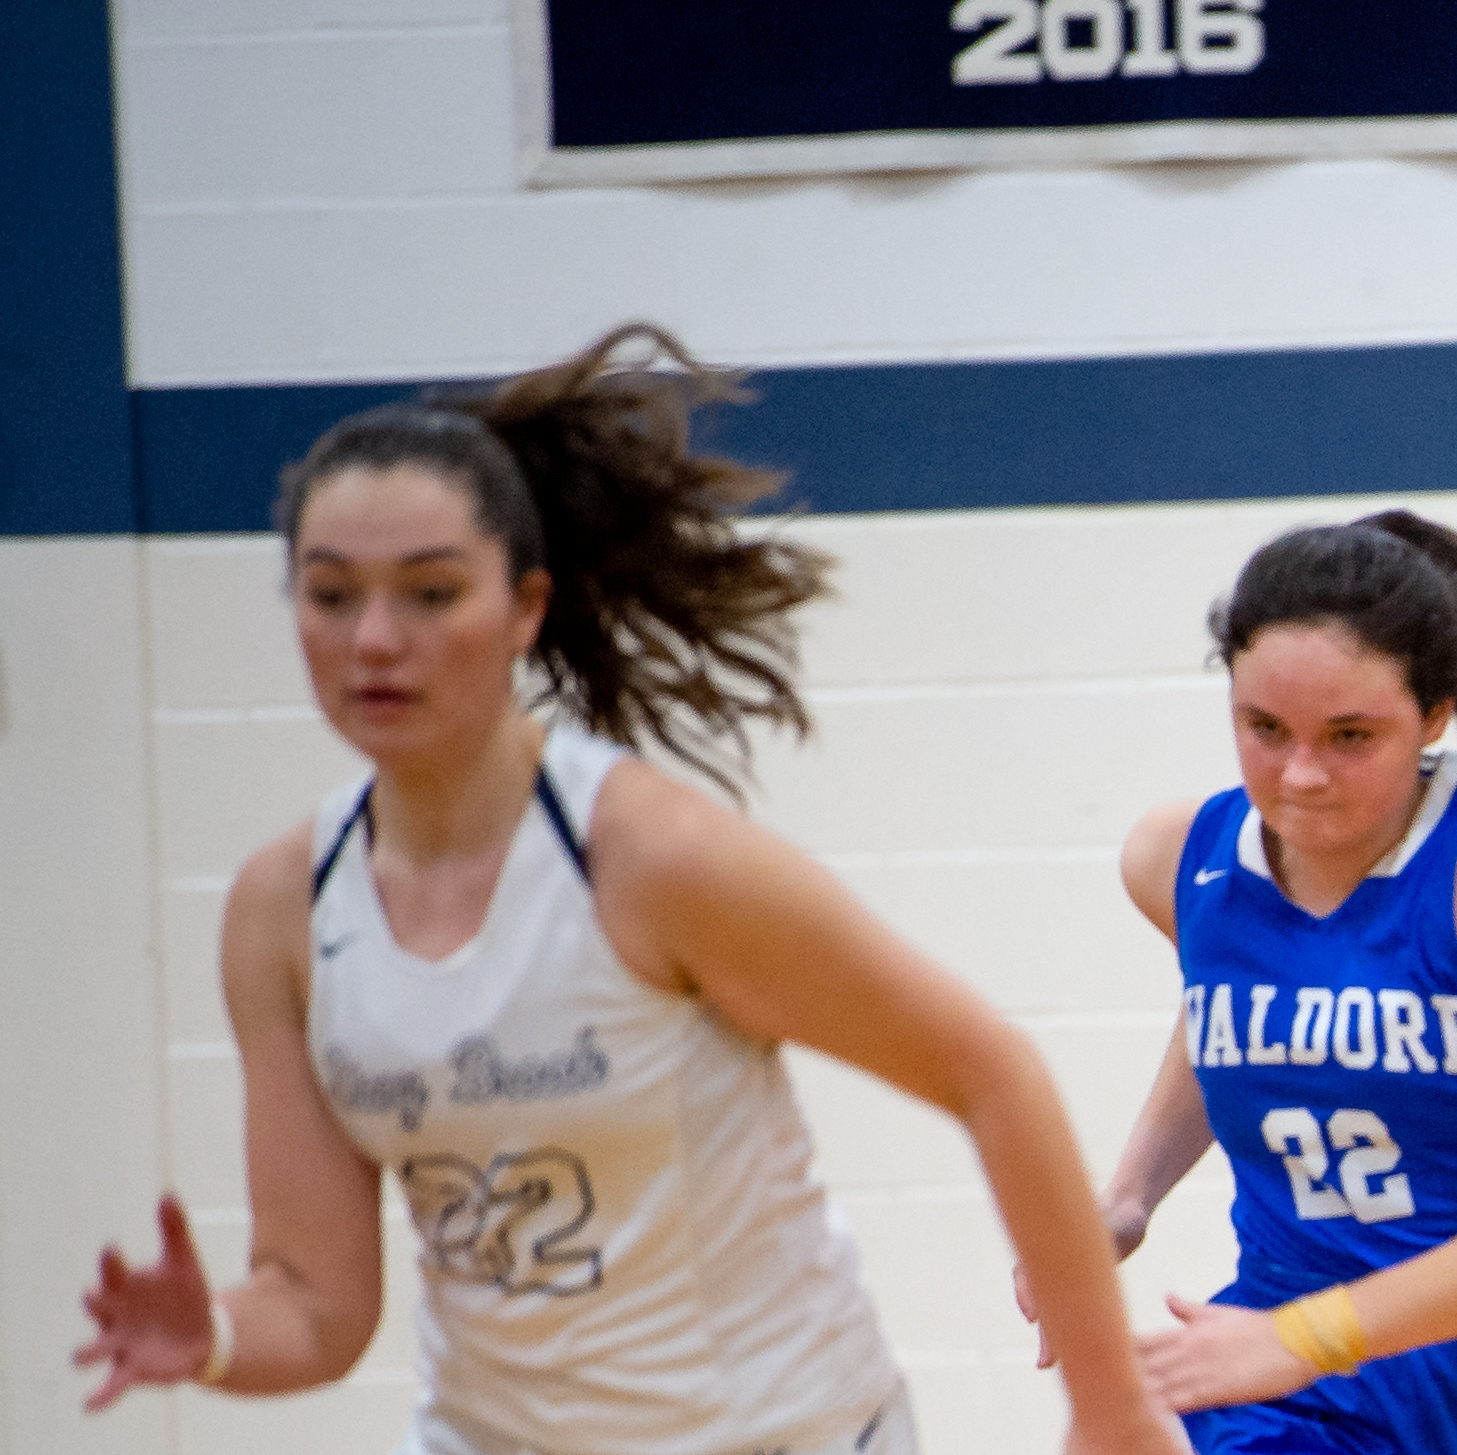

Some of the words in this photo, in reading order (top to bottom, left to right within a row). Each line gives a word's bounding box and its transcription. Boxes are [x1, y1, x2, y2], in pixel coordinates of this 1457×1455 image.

[949, 0, 1267, 86] 2016
[401, 1145, 604, 1297] 22
[1261, 1106, 1416, 1225] 22
